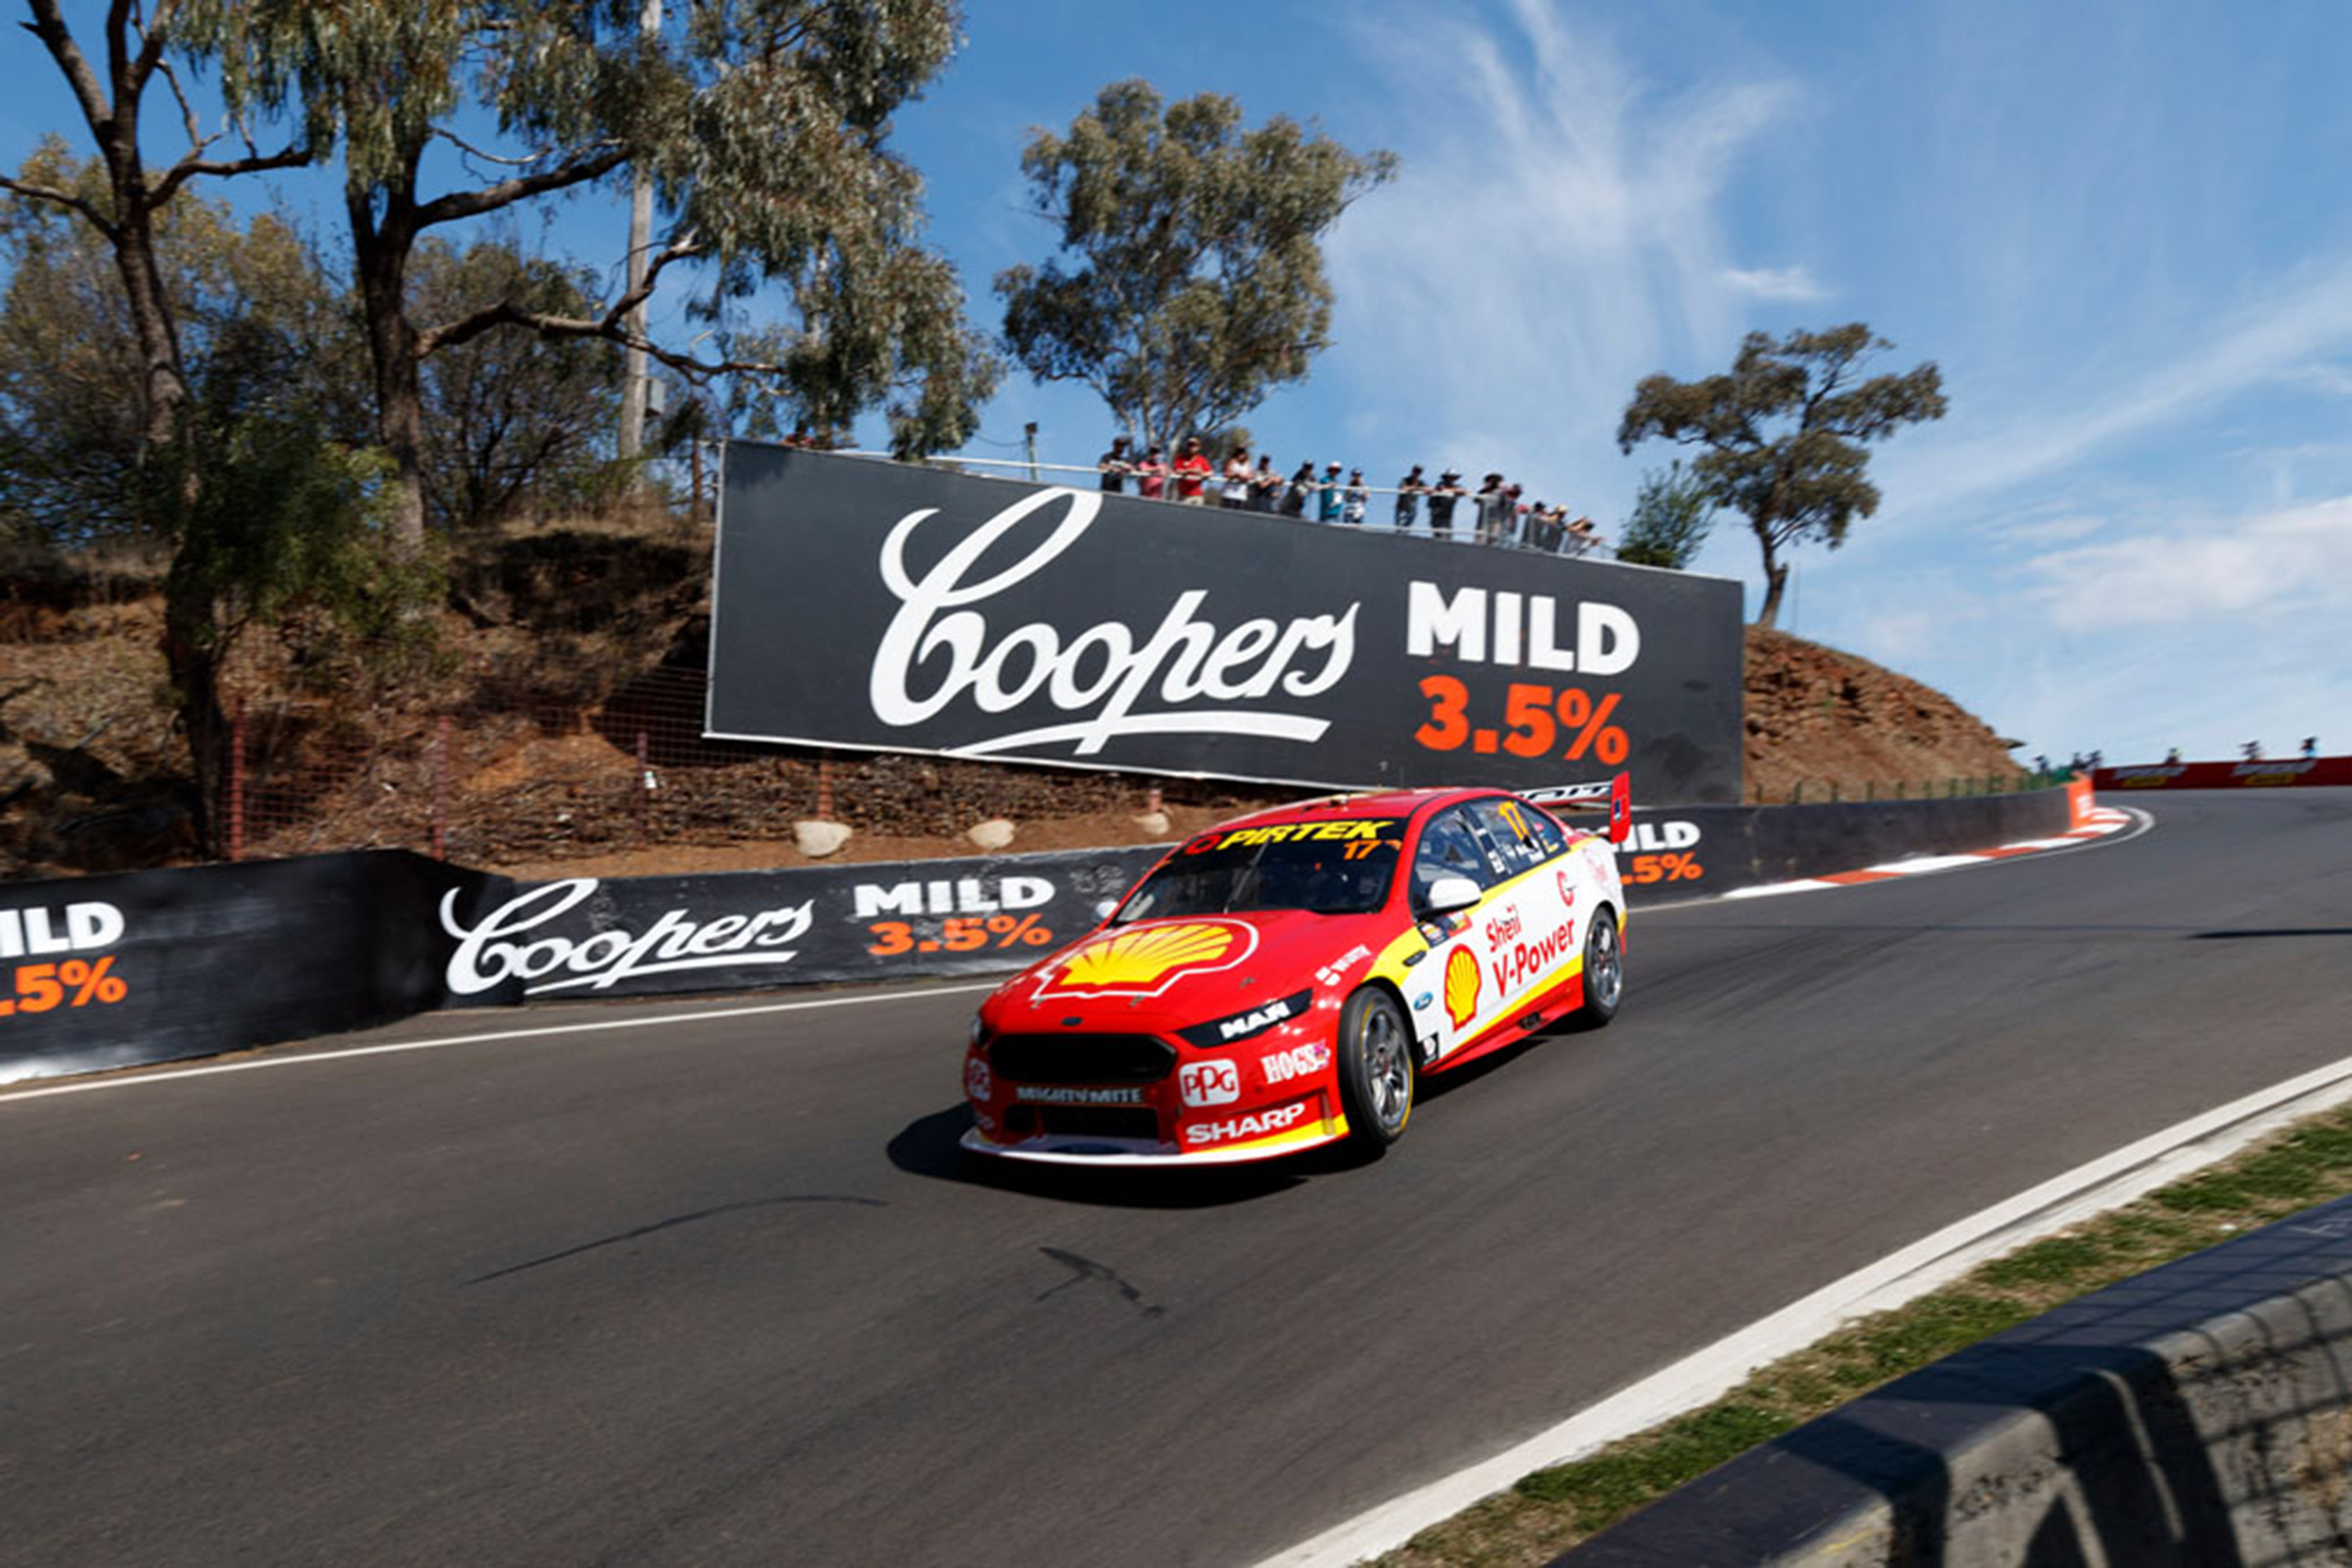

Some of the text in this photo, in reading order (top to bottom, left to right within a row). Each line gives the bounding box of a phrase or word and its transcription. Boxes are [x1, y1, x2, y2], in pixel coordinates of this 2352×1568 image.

[870, 487, 1360, 755] Coopers
[1406, 580, 1640, 675] MILD
[1414, 674, 1629, 766] 3.5%
[1215, 821, 1396, 851] PIRTEK
[1344, 839, 1382, 859] 17
[1612, 820, 1701, 853] ILD
[1619, 851, 1703, 885] .5%
[854, 876, 1055, 918] MILD
[440, 878, 814, 995] Coopers
[868, 912, 1054, 956] 3.5%
[1486, 904, 1522, 953] Shell
[1493, 918, 1575, 998] V-Power
[1219, 1001, 1291, 1039] MAN
[1182, 1065, 1236, 1102] PPG
[1185, 1102, 1305, 1145] SHARP
